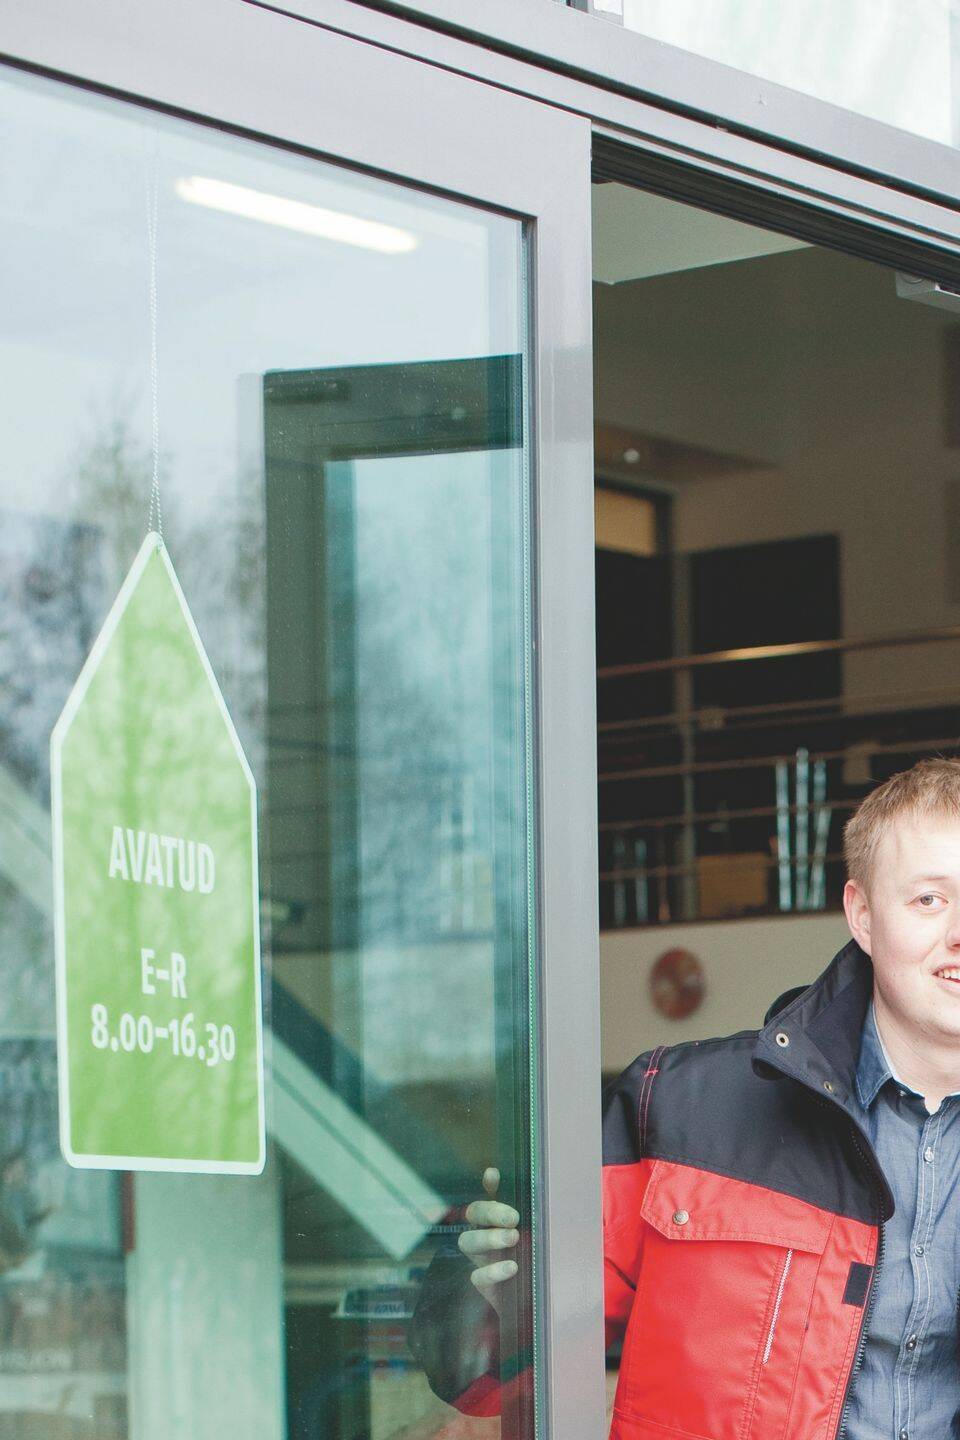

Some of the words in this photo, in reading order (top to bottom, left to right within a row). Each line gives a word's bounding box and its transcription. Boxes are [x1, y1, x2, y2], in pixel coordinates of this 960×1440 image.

[108, 825, 216, 894] AVATUD
[141, 948, 188, 998] E-R
[91, 1004, 236, 1066] 8.00-16.30
